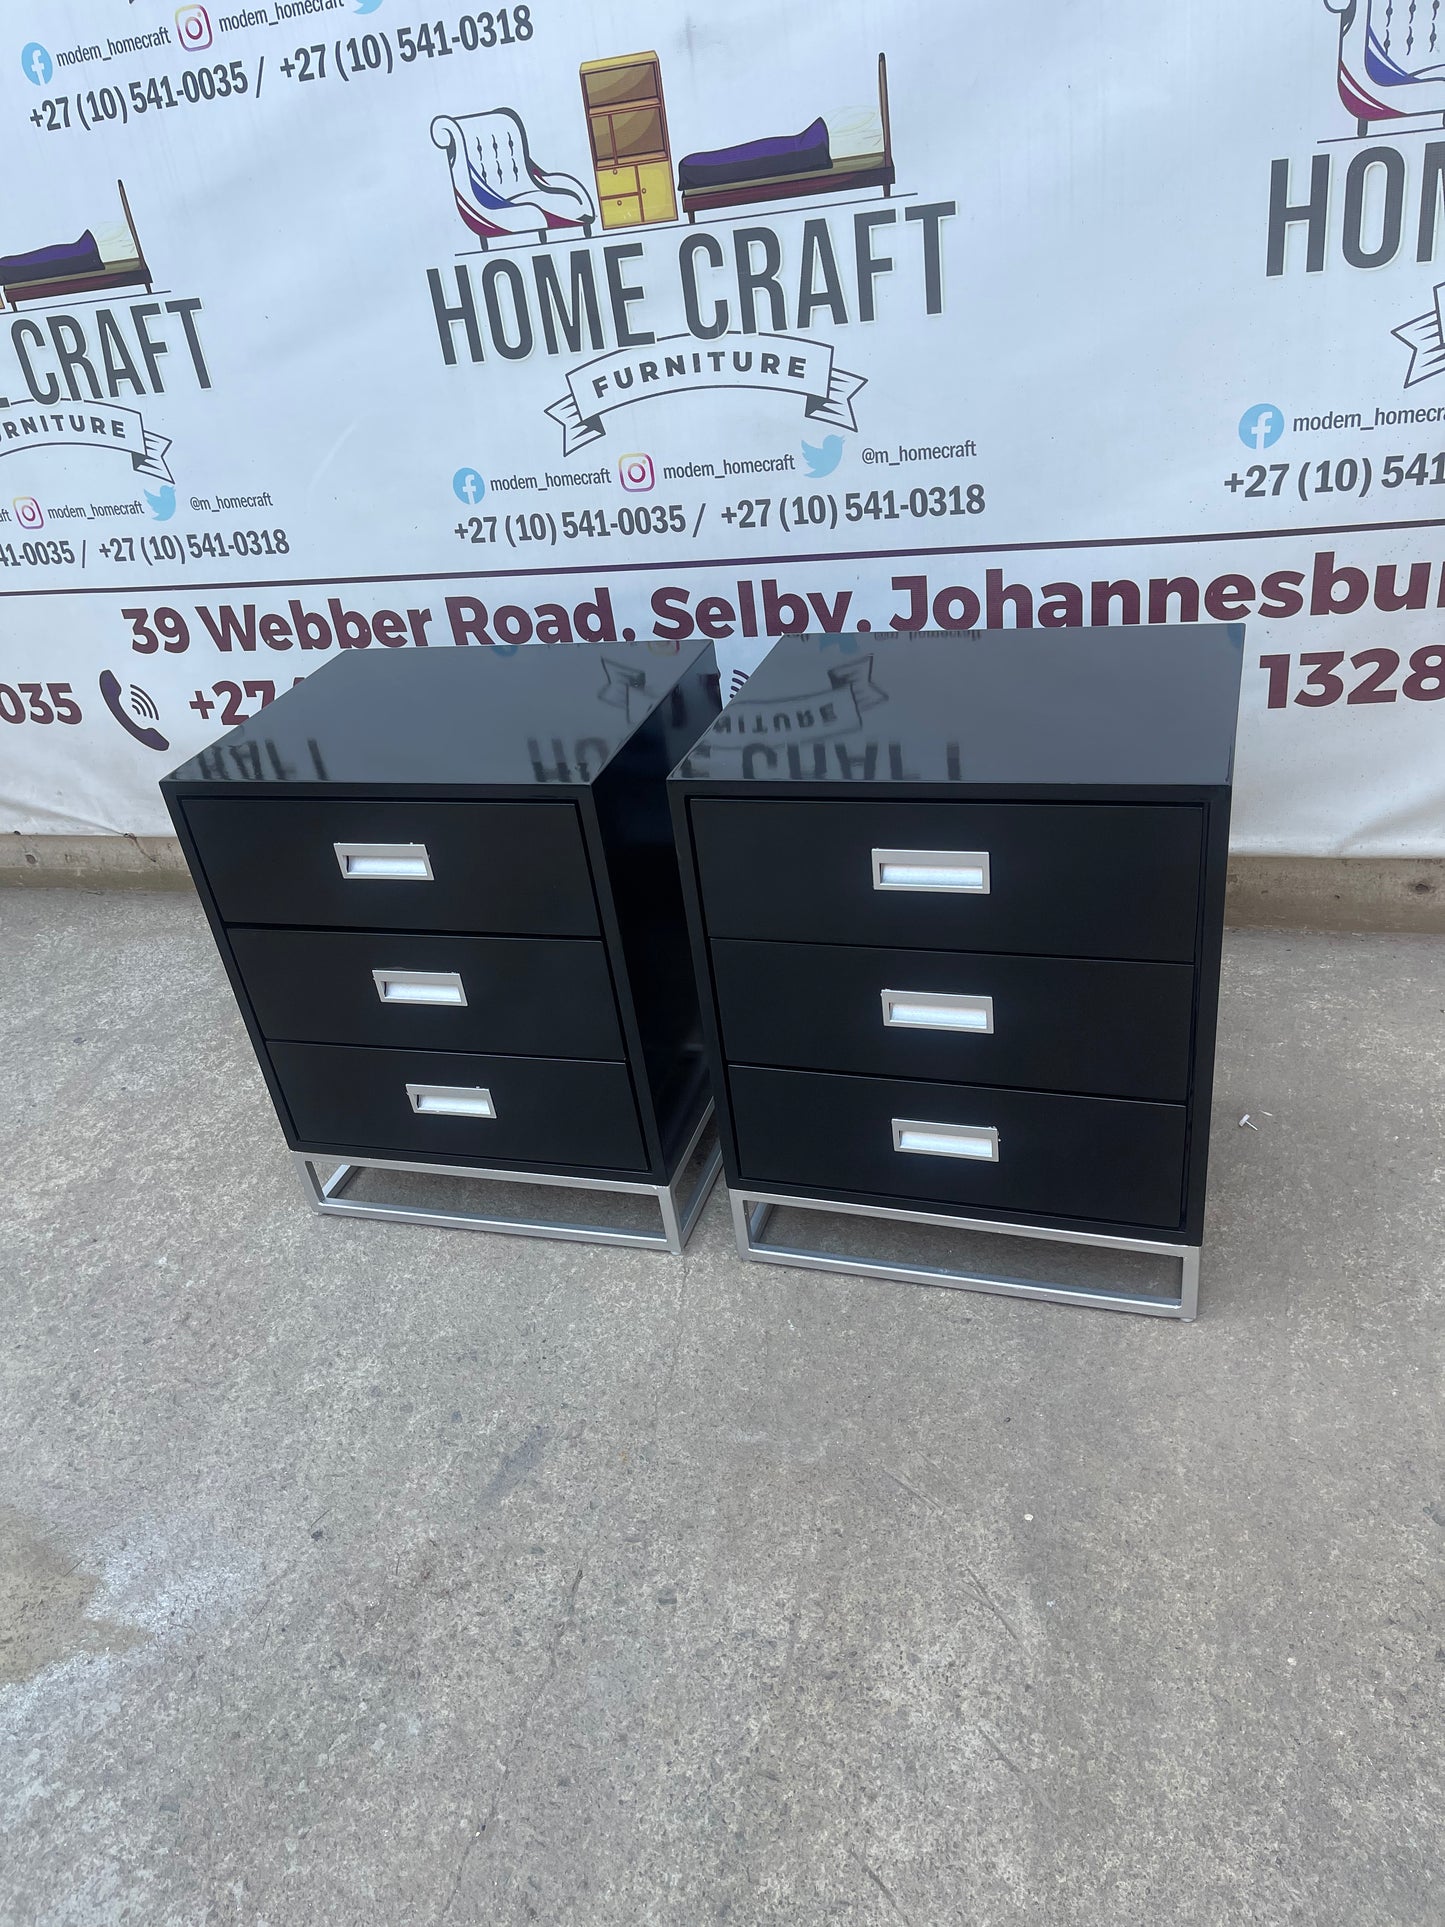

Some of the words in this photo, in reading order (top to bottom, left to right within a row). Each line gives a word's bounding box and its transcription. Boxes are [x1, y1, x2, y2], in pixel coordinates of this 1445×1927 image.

[29, 96, 71, 132] +27
[76, 85, 128, 131] (10)
[128, 60, 249, 114] 541-0035
[279, 43, 327, 83] +27
[334, 32, 394, 82] (10)
[396, 4, 534, 63] 541-0318
[425, 242, 656, 366] HOME
[678, 200, 956, 340] CRAFT
[10, 297, 212, 406] CRAFT
[591, 351, 807, 399] FURNITURE
[0, 414, 126, 442] RNITURE
[861, 439, 977, 467] @m_homecraft
[189, 491, 274, 513] @m_homecraft
[1224, 463, 1290, 498] +27
[1298, 457, 1372, 502] (10)
[454, 516, 498, 544] +27
[505, 512, 557, 548] (10)
[561, 504, 687, 539] 541-0035
[720, 498, 771, 529] +27
[779, 494, 838, 533] (10)
[845, 483, 986, 522] 541-0318
[98, 537, 136, 562] +27
[140, 534, 186, 567] (10)
[185, 528, 290, 559] 541-0318
[120, 606, 191, 655] 39
[195, 598, 432, 651] Webber
[889, 551, 1445, 631] Johannesbu
